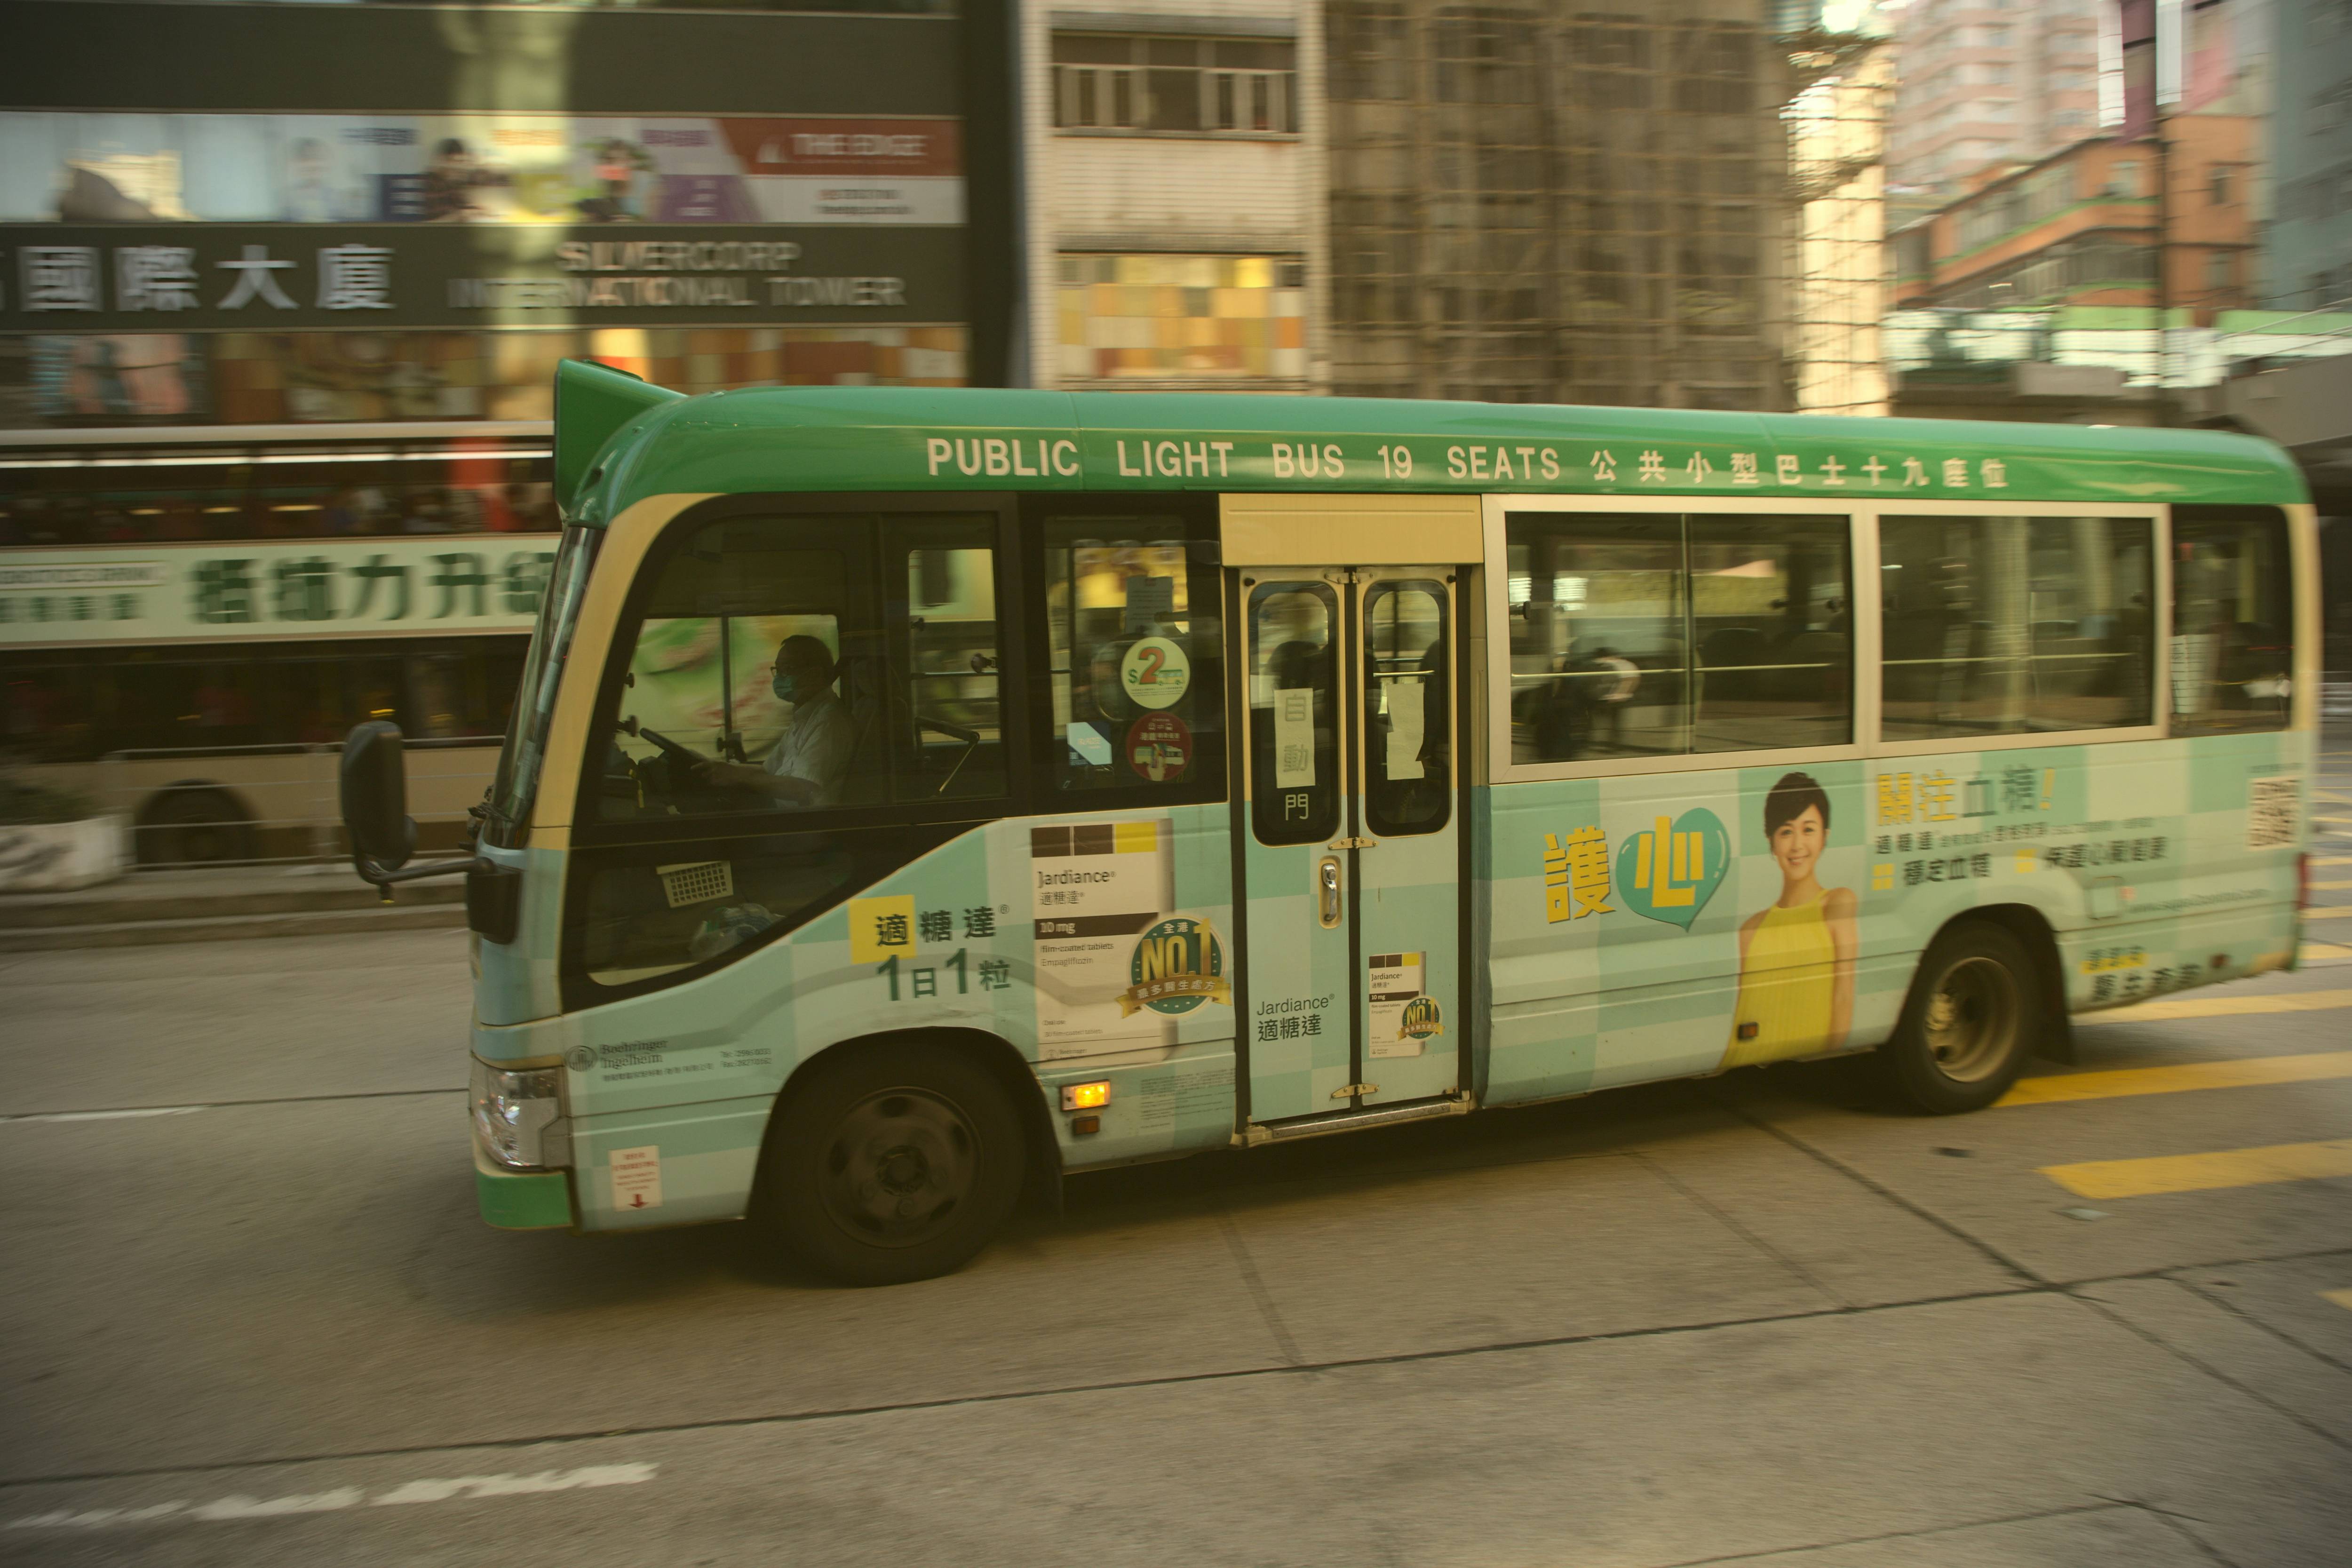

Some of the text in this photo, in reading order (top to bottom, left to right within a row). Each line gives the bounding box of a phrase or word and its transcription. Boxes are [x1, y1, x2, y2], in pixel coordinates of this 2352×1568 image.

[556, 241, 803, 271] SILVERCORP
[17, 245, 396, 312] 國際大廈
[763, 277, 908, 307] TOWER
[927, 438, 2009, 488] PUBLIC LIGHT BUS 19 SEATS 公共小型巴士十九座位
[1543, 816, 1704, 924] 護心
[1039, 922, 1076, 934] 10 mg
[1163, 922, 1189, 934] 全港
[876, 947, 1011, 1001] 1日1粒
[1257, 1013, 1322, 1043] 適糖達
